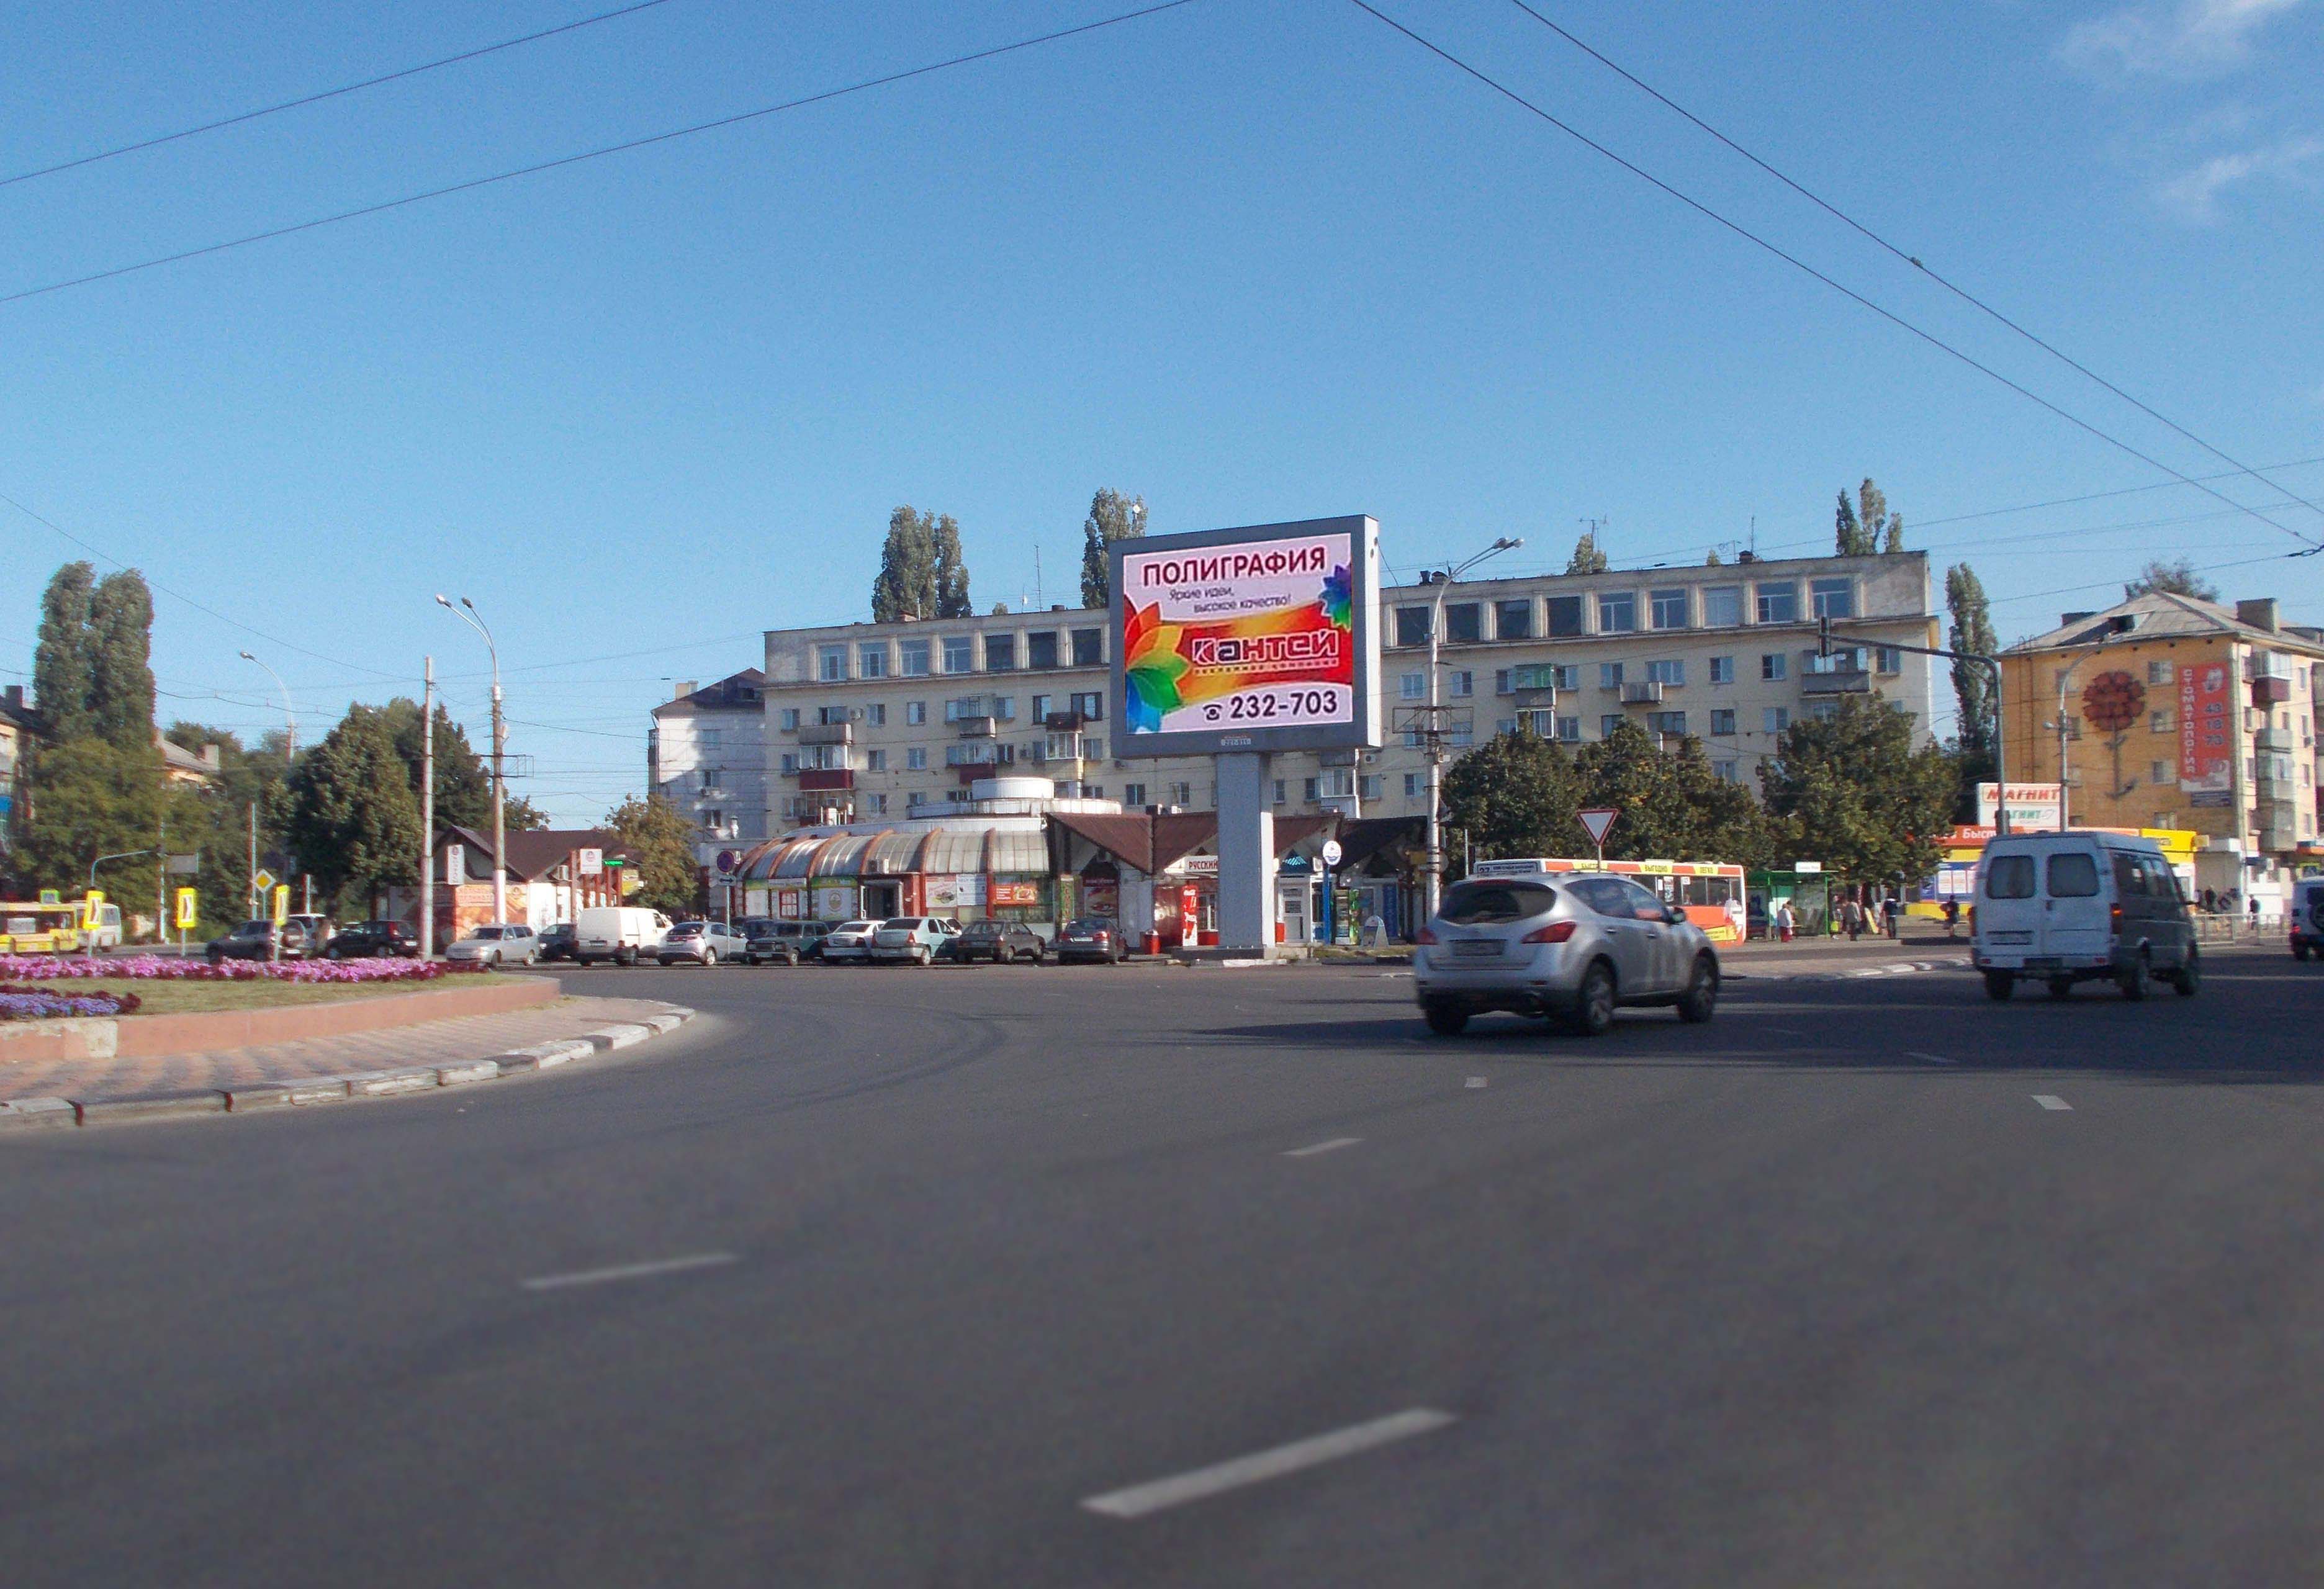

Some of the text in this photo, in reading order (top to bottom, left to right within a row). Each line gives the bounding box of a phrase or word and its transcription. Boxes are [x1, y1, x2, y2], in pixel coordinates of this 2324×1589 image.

[1144, 546, 1325, 587] ПОЛИГРАФИЯ
[1169, 589, 1202, 604] Яркие
[1194, 593, 1291, 613] высокое качество!
[1230, 690, 1338, 719] 232-703
[2182, 668, 2196, 773] СТОМАТОЛОГИЯ
[1986, 788, 2060, 801] МАГНИТ
[1189, 859, 1218, 870] РУССКИЙ
